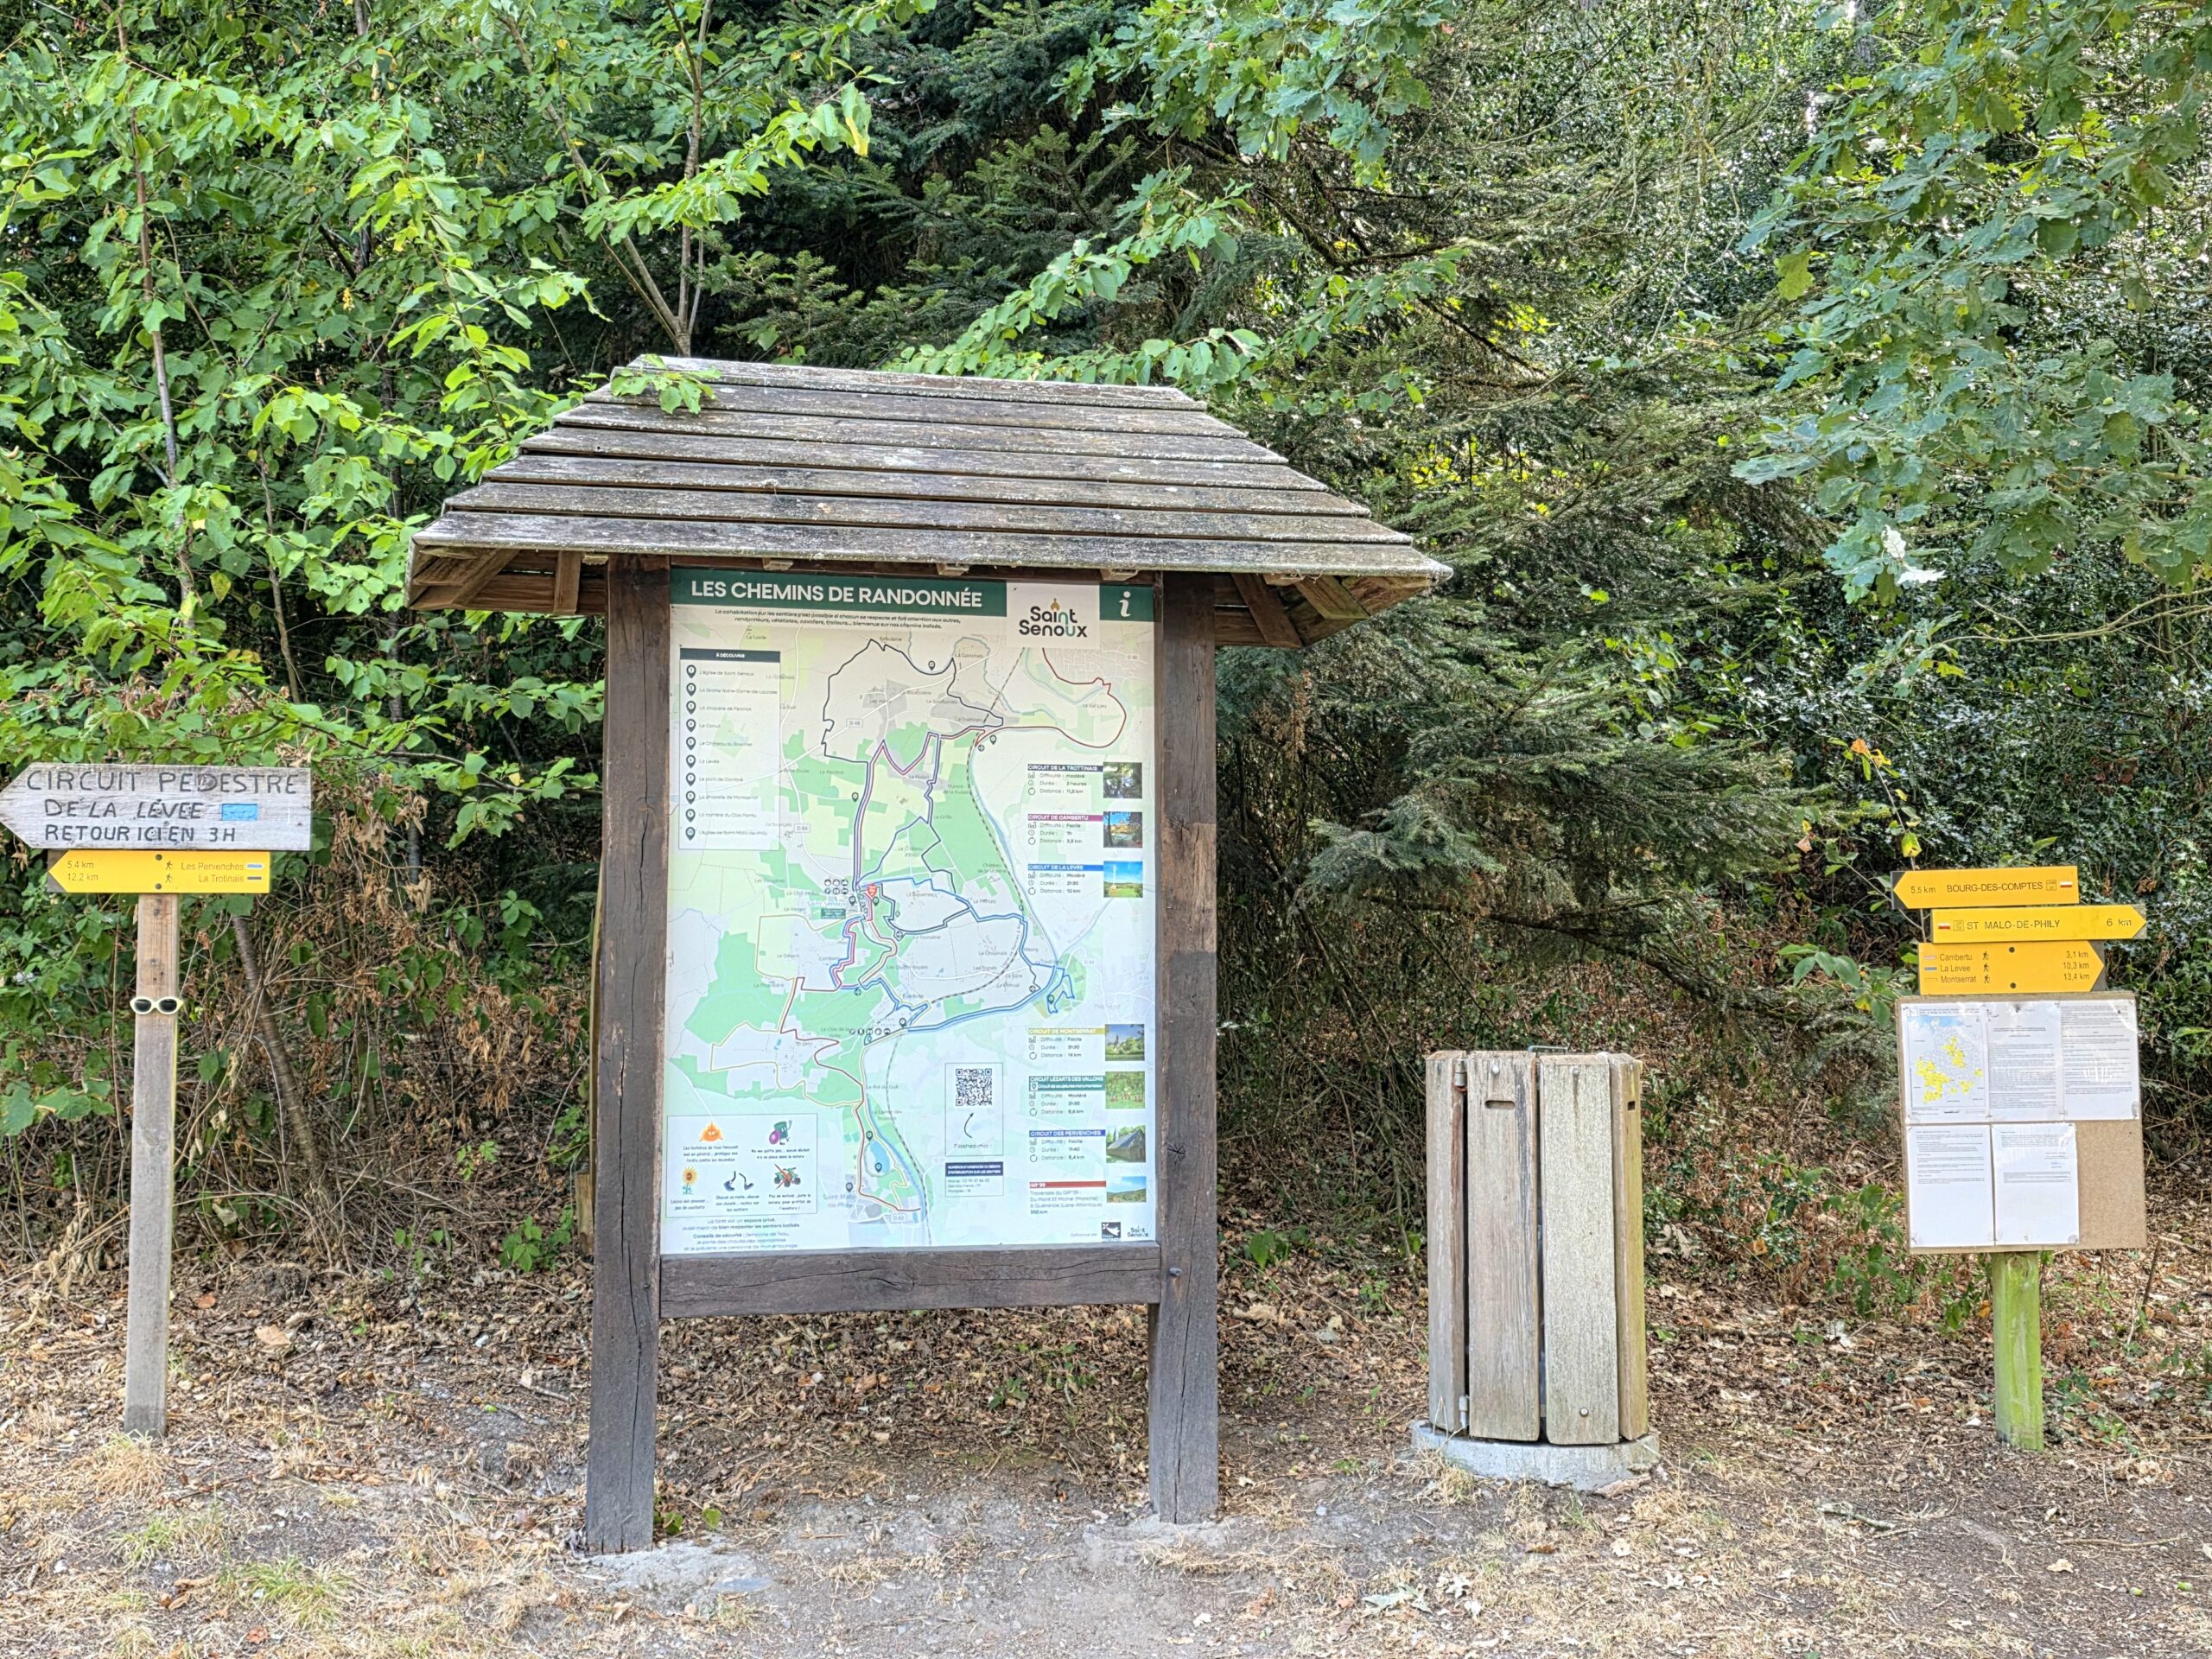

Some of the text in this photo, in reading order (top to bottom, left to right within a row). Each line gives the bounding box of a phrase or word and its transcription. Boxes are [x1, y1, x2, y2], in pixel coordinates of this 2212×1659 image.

[691, 580, 983, 607] LES CHEMINS DE RANDONNÉE
[1030, 605, 1077, 624] Saint
[1019, 620, 1088, 638] Senoux
[27, 770, 141, 791] CIRCUIT
[44, 798, 79, 817] DE
[88, 801, 117, 817] LA
[45, 823, 130, 841] RETOUR
[137, 826, 162, 842] ICI
[168, 826, 194, 842] EN
[82, 861, 94, 869] km
[181, 862, 245, 871] Les Pervenches
[86, 873, 99, 881] km
[1947, 881, 2044, 893] BOURG-DES-COMPTES
[1967, 921, 1980, 930] ST
[2106, 918, 2113, 927] 6
